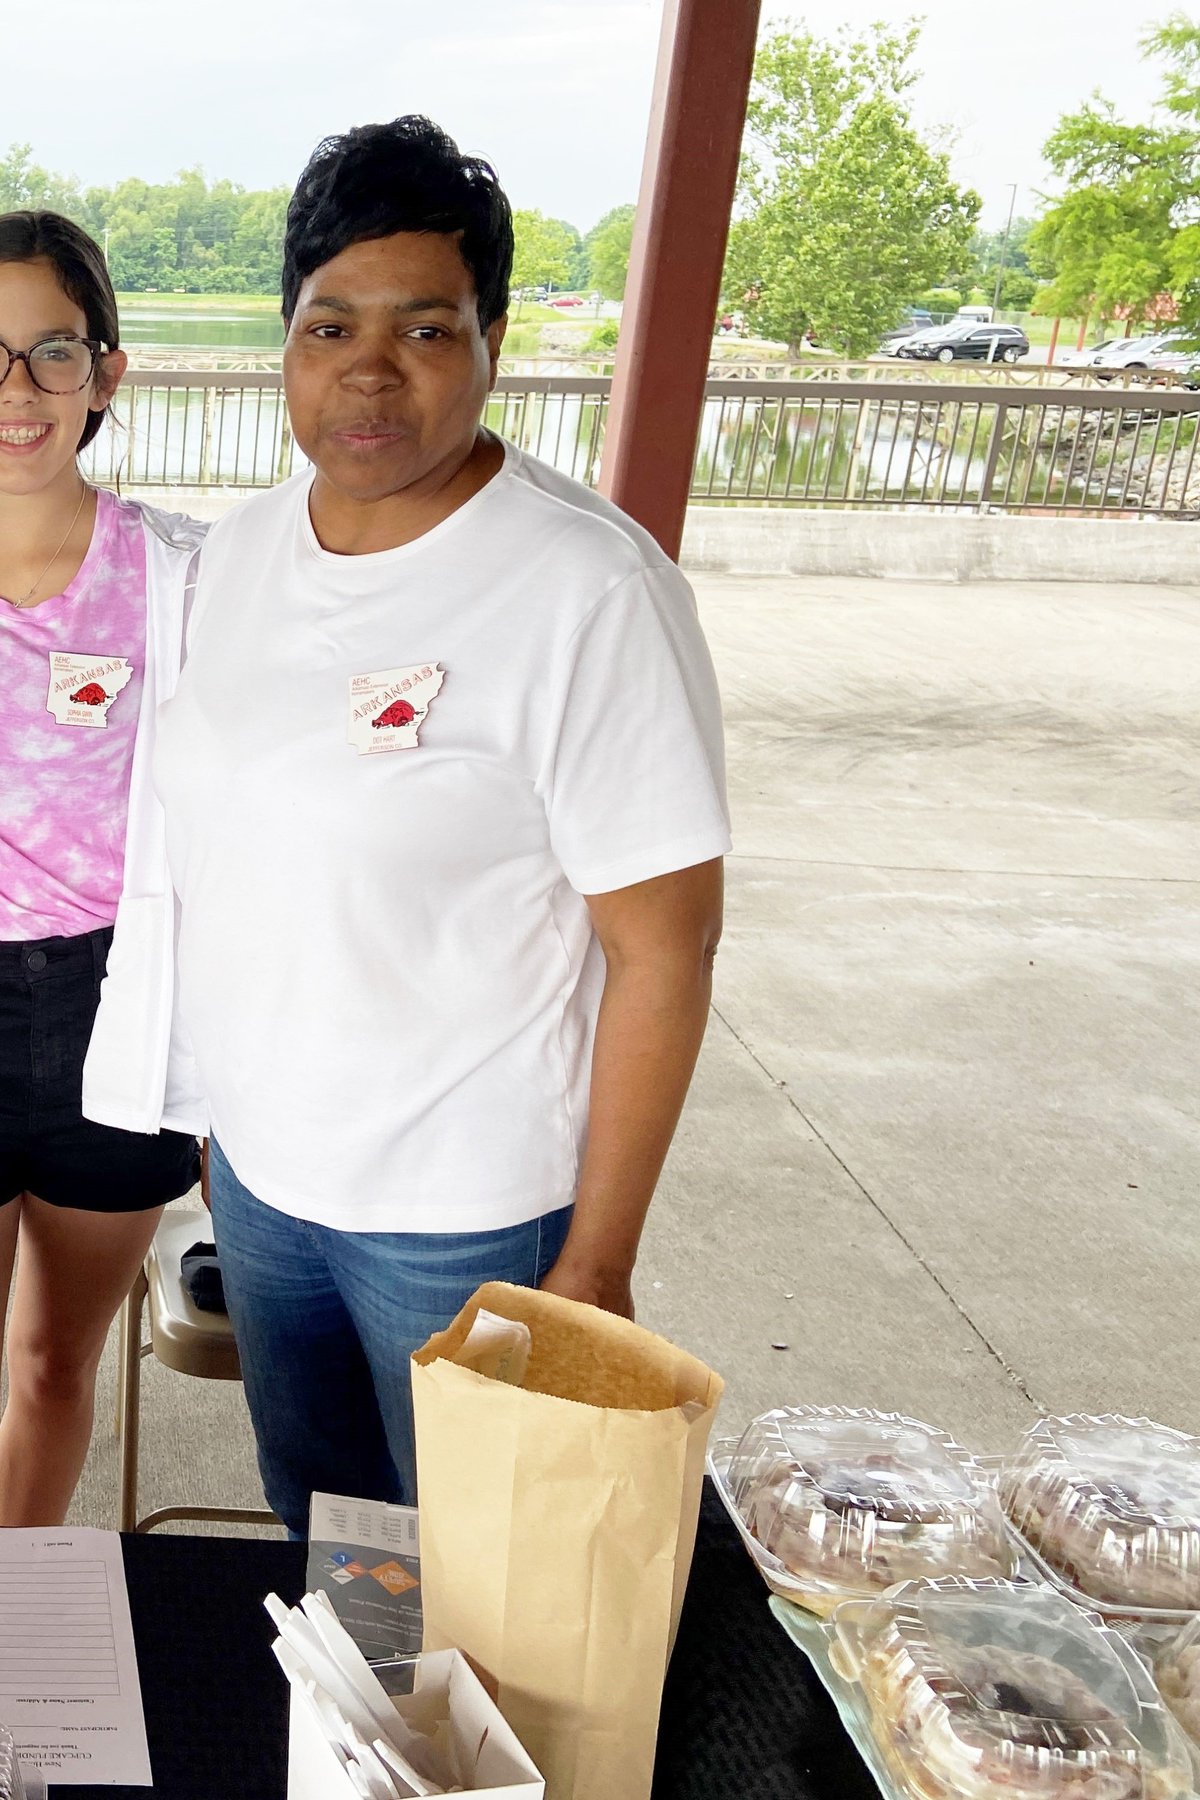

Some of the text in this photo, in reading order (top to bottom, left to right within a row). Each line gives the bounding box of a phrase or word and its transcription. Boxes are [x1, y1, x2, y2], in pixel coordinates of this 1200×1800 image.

[55, 656, 70, 665] AEHC
[54, 660, 122, 693] ARKANSAS
[352, 677, 370, 687] AEHC
[353, 667, 432, 722] ARKANSAS
